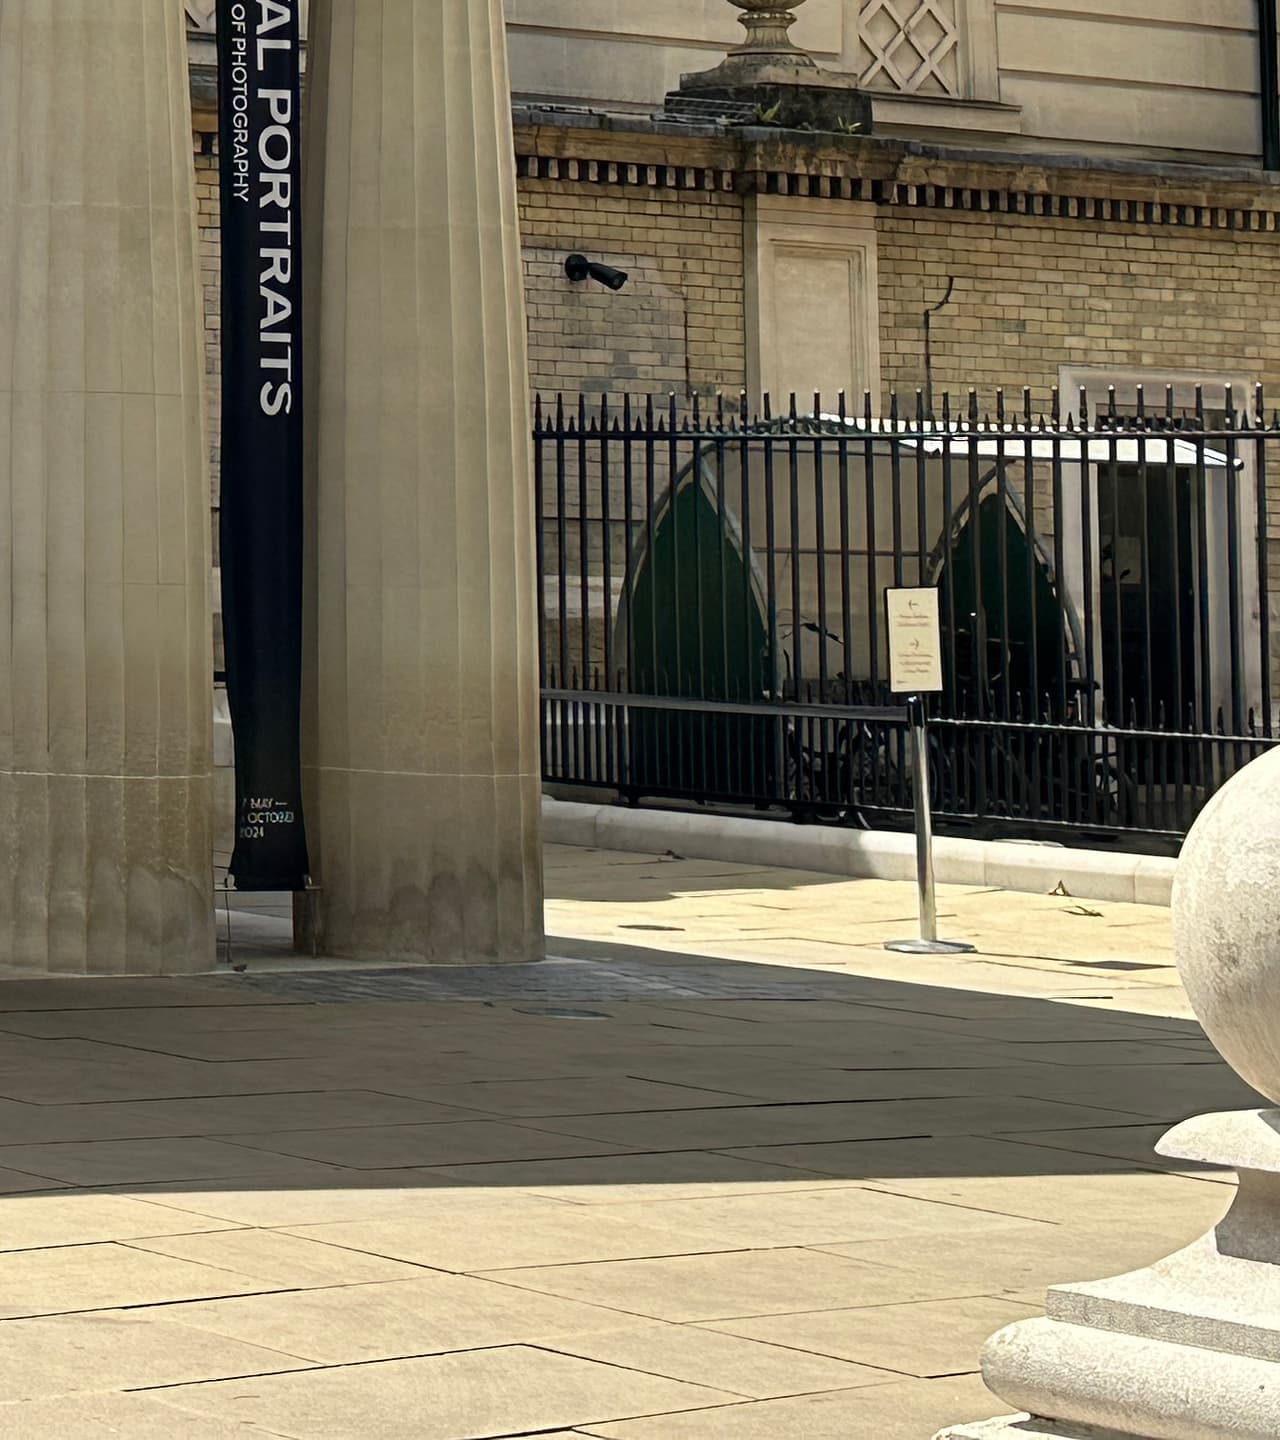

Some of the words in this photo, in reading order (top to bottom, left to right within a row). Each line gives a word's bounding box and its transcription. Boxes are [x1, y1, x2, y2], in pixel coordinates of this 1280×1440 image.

[231, 3, 247, 35] OF
[230, 37, 249, 202] PHOTOGRAPHY
[257, 88, 292, 417] PORTRAITS
